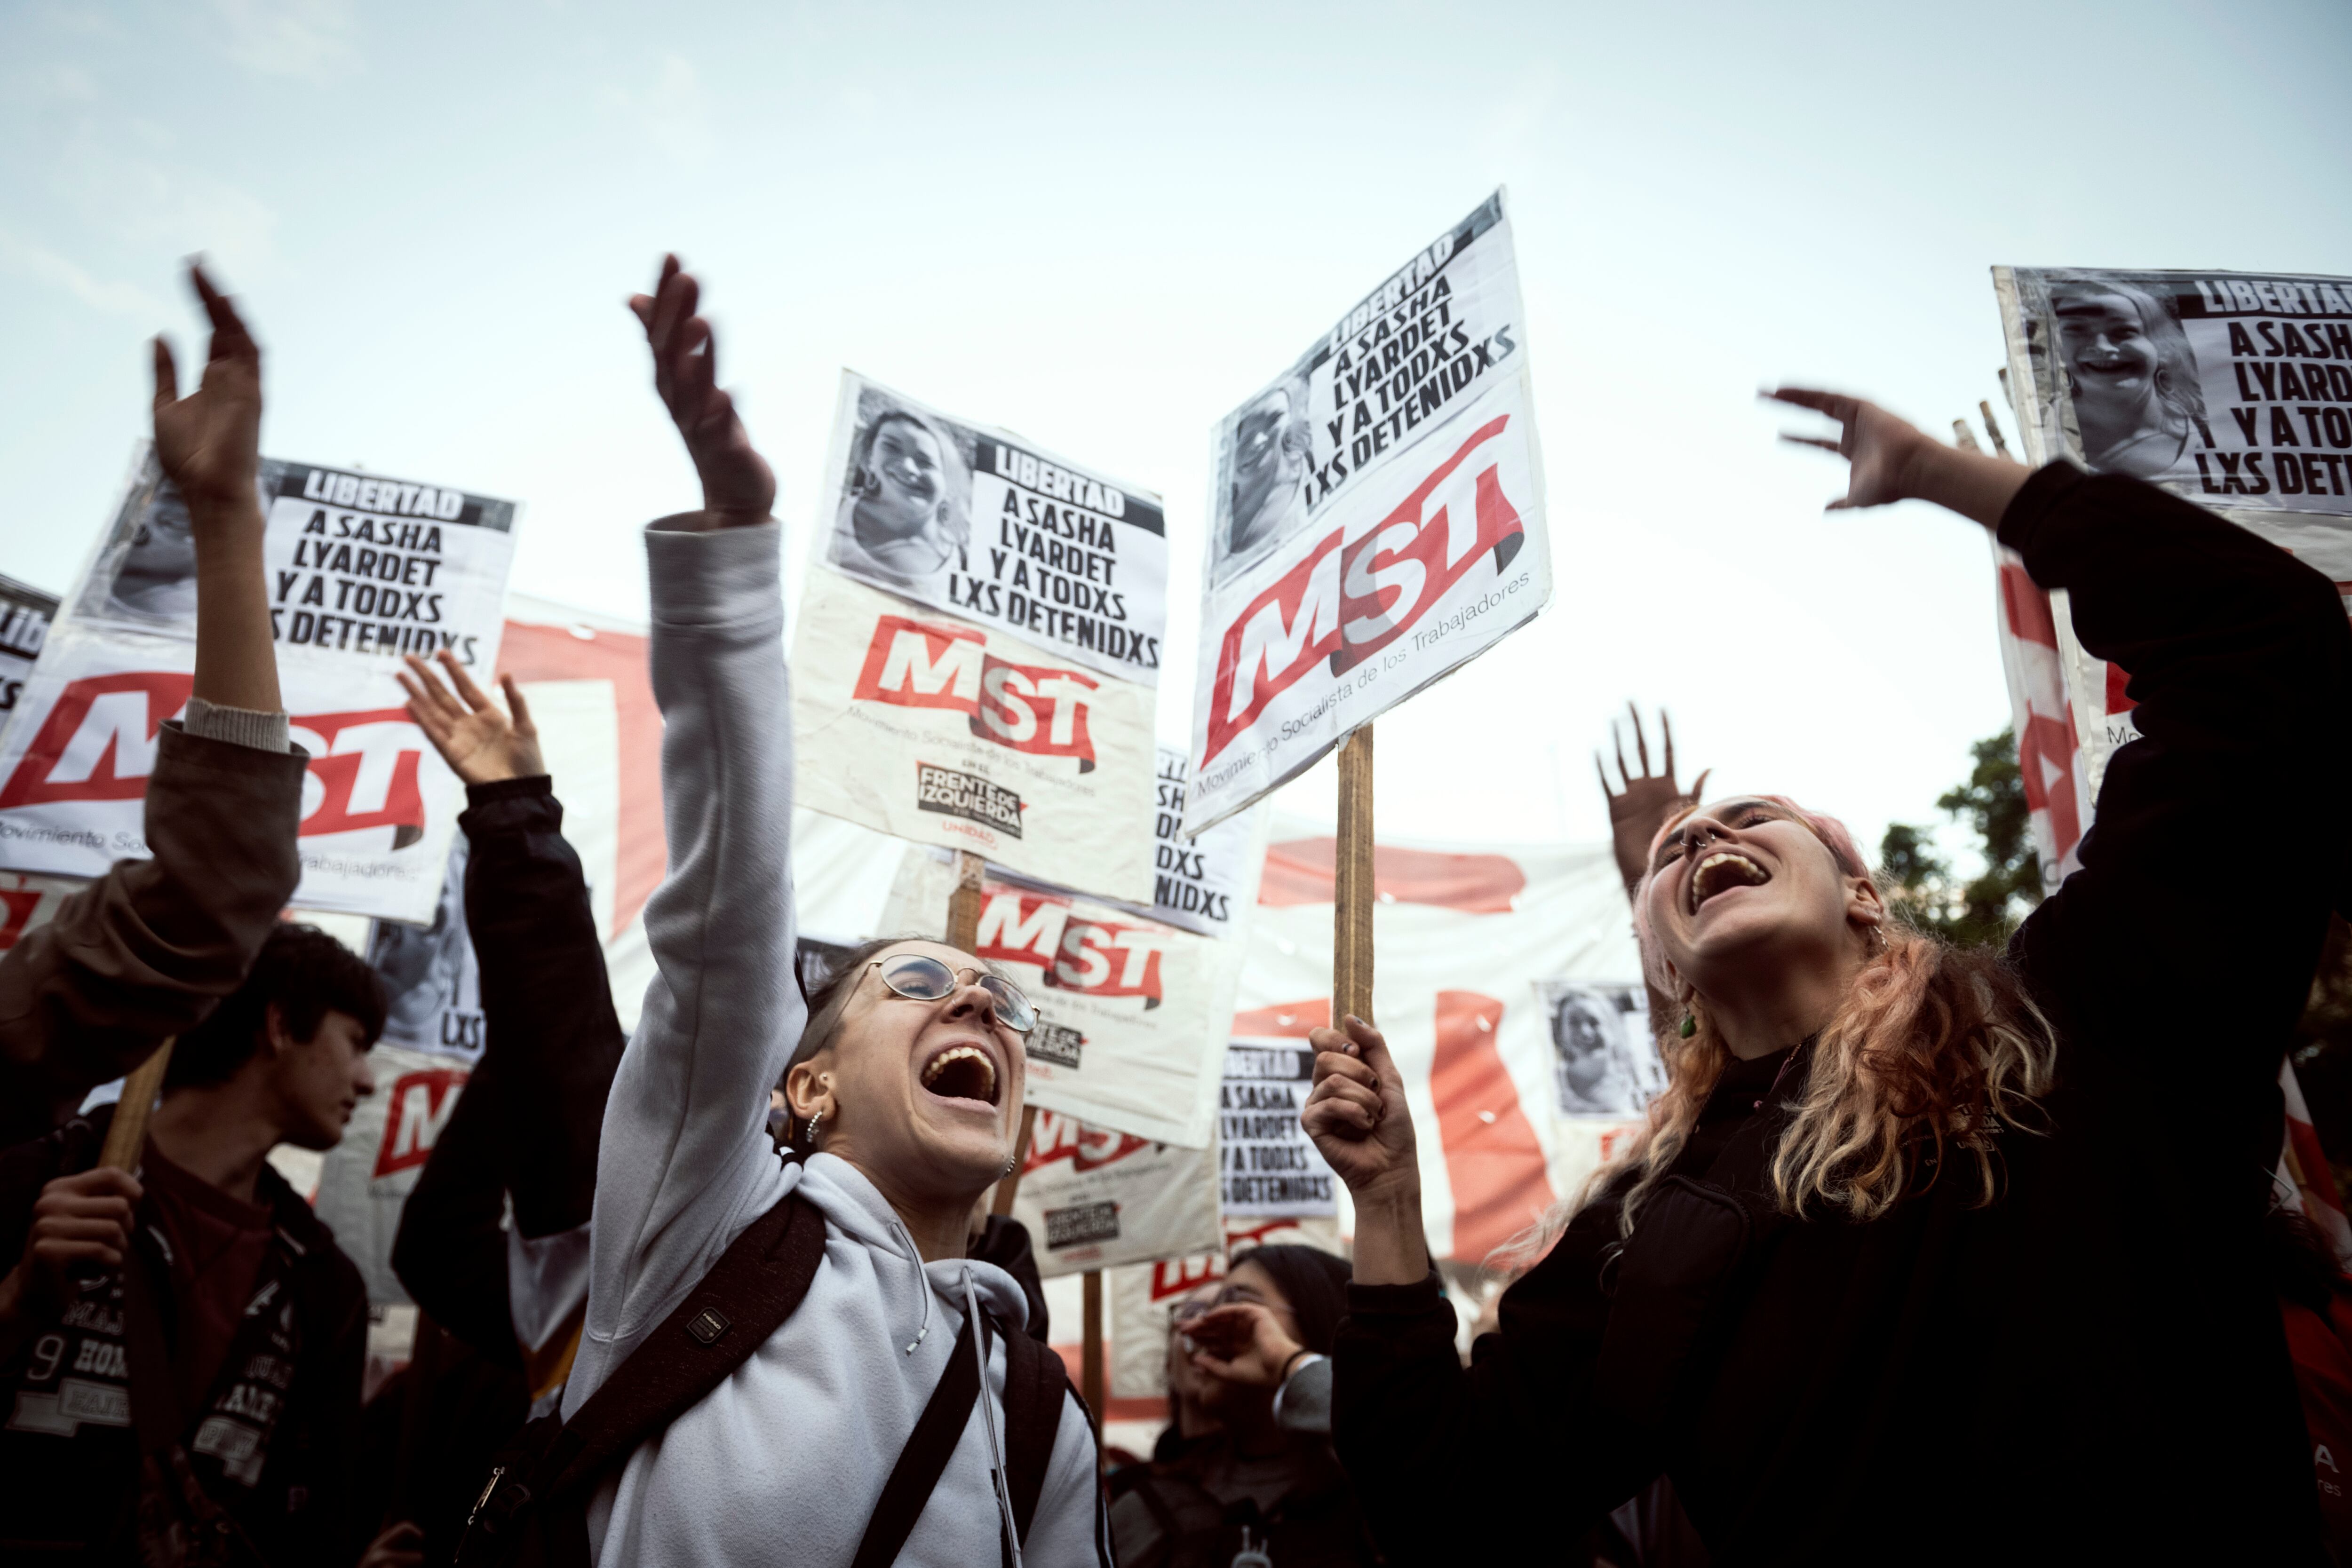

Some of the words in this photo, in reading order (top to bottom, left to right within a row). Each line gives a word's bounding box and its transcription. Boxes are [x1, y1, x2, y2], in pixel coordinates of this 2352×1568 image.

[1329, 234, 1454, 355] LIBERTAD
[1335, 350, 1351, 379] A
[1358, 274, 1451, 363] SASHA
[2228, 322, 2258, 356] A
[2257, 321, 2352, 360] SASH
[1335, 296, 1453, 411] LYARDET
[1327, 412, 1344, 448] Y
[1353, 398, 1373, 436] A
[1375, 318, 1469, 415] TODXS
[1352, 324, 1515, 472] DETENIDXS
[2231, 407, 2258, 446] Y
[2271, 406, 2300, 447] A
[2297, 406, 2352, 448] TO
[303, 470, 465, 521] LIBERTAD
[996, 444, 1125, 518] LIBERTAD
[2195, 452, 2270, 495] LXS
[305, 509, 326, 535] A
[334, 516, 442, 553] SASHA
[1004, 488, 1019, 518] A
[1027, 498, 1115, 553] SASHA
[293, 539, 442, 586] LYARDET
[1001, 518, 1116, 586] LYARDET
[1227, 429, 1503, 723] MST
[277, 570, 299, 602] Y
[301, 575, 324, 606] A
[335, 579, 443, 623] TODXS
[990, 548, 1007, 580] Y
[1013, 560, 1030, 591] A
[1037, 567, 1126, 621] TODXS
[289, 611, 477, 665] DETENIDXS
[949, 573, 1001, 616] LXS
[1008, 591, 1159, 669] DETENIDXS
[1281, 684, 1353, 742] Socialista
[1358, 668, 1377, 689] de
[1383, 650, 1406, 673] los
[1411, 571, 1529, 652] Trabajadores
[878, 628, 1098, 745] MST
[919, 784, 1022, 827] IZQUIERDA
[920, 767, 998, 800] FRENTE
[997, 791, 1017, 809] DE
[0, 821, 106, 848] ovimiento
[942, 821, 996, 844] UNIDAD
[1156, 846, 1206, 880] DXS
[1155, 874, 1230, 922] NIDXS
[977, 895, 1168, 988] MST
[443, 1011, 481, 1050] LXS
[1235, 1085, 1296, 1110] SASHA
[1233, 1146, 1245, 1171] A
